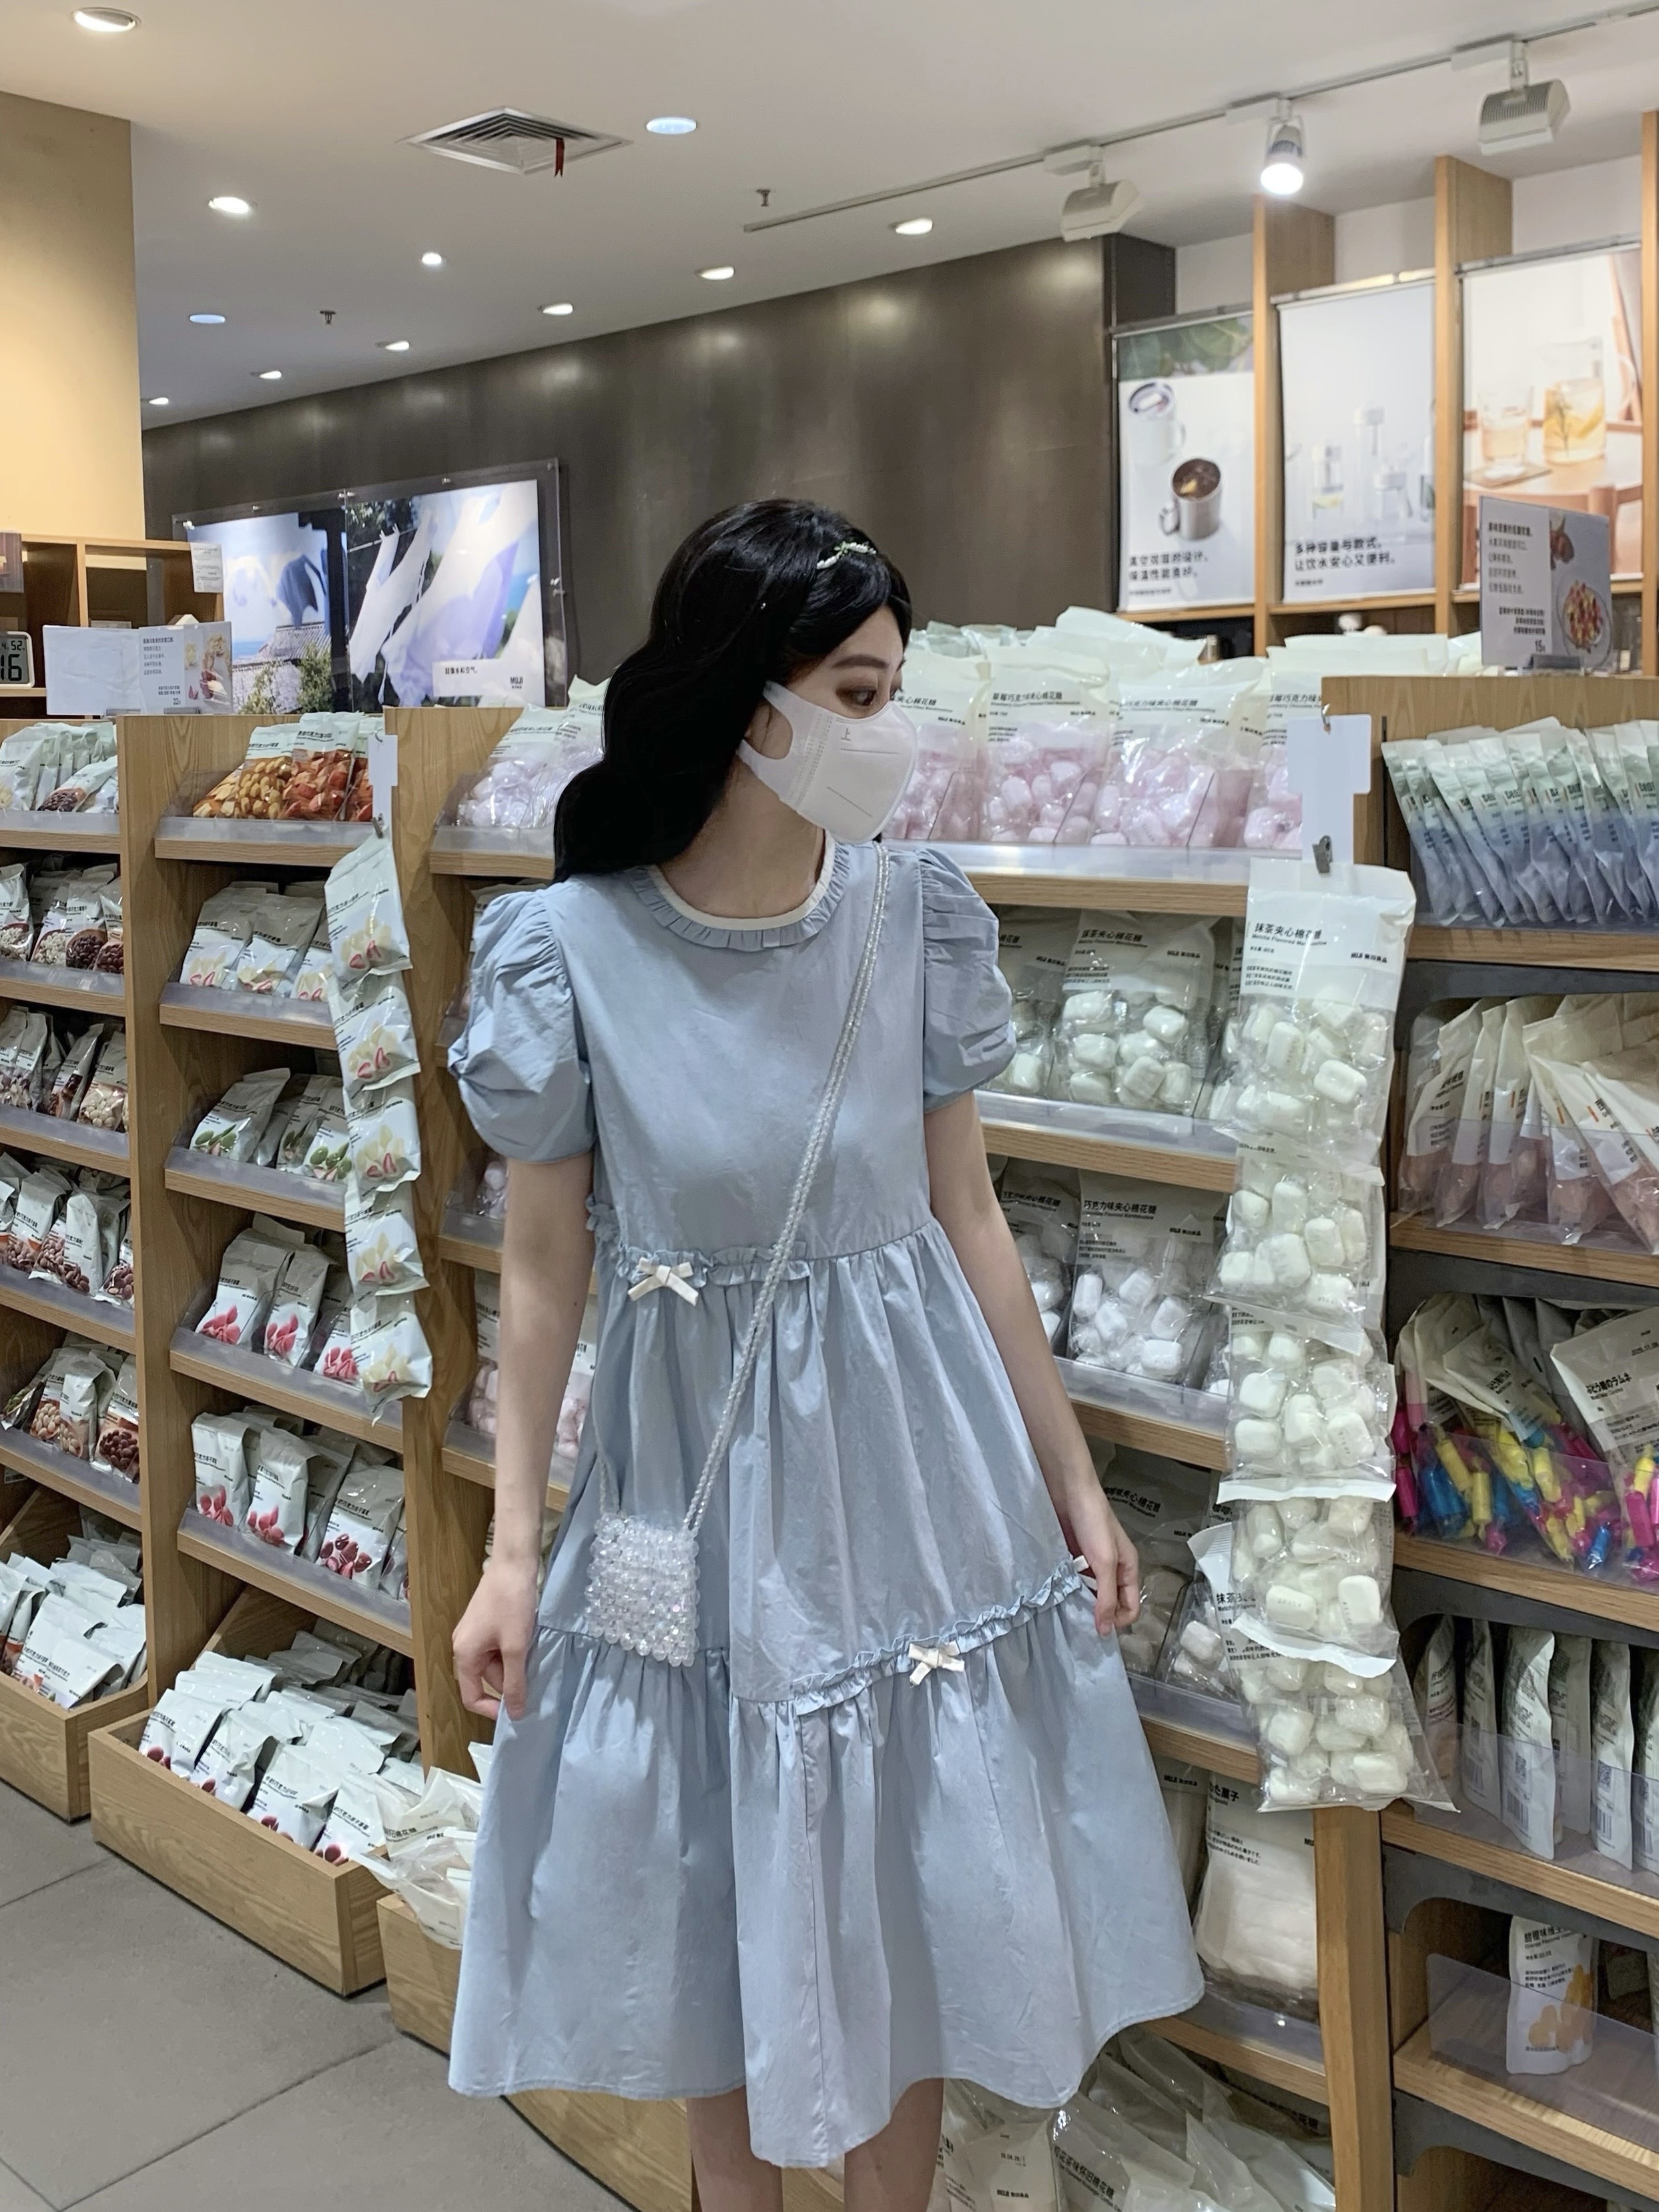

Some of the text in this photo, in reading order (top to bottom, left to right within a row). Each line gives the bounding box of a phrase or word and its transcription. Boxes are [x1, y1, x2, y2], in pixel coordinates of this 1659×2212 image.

[1083, 1201, 1157, 1214] 巧克力味夹心棉花糖
